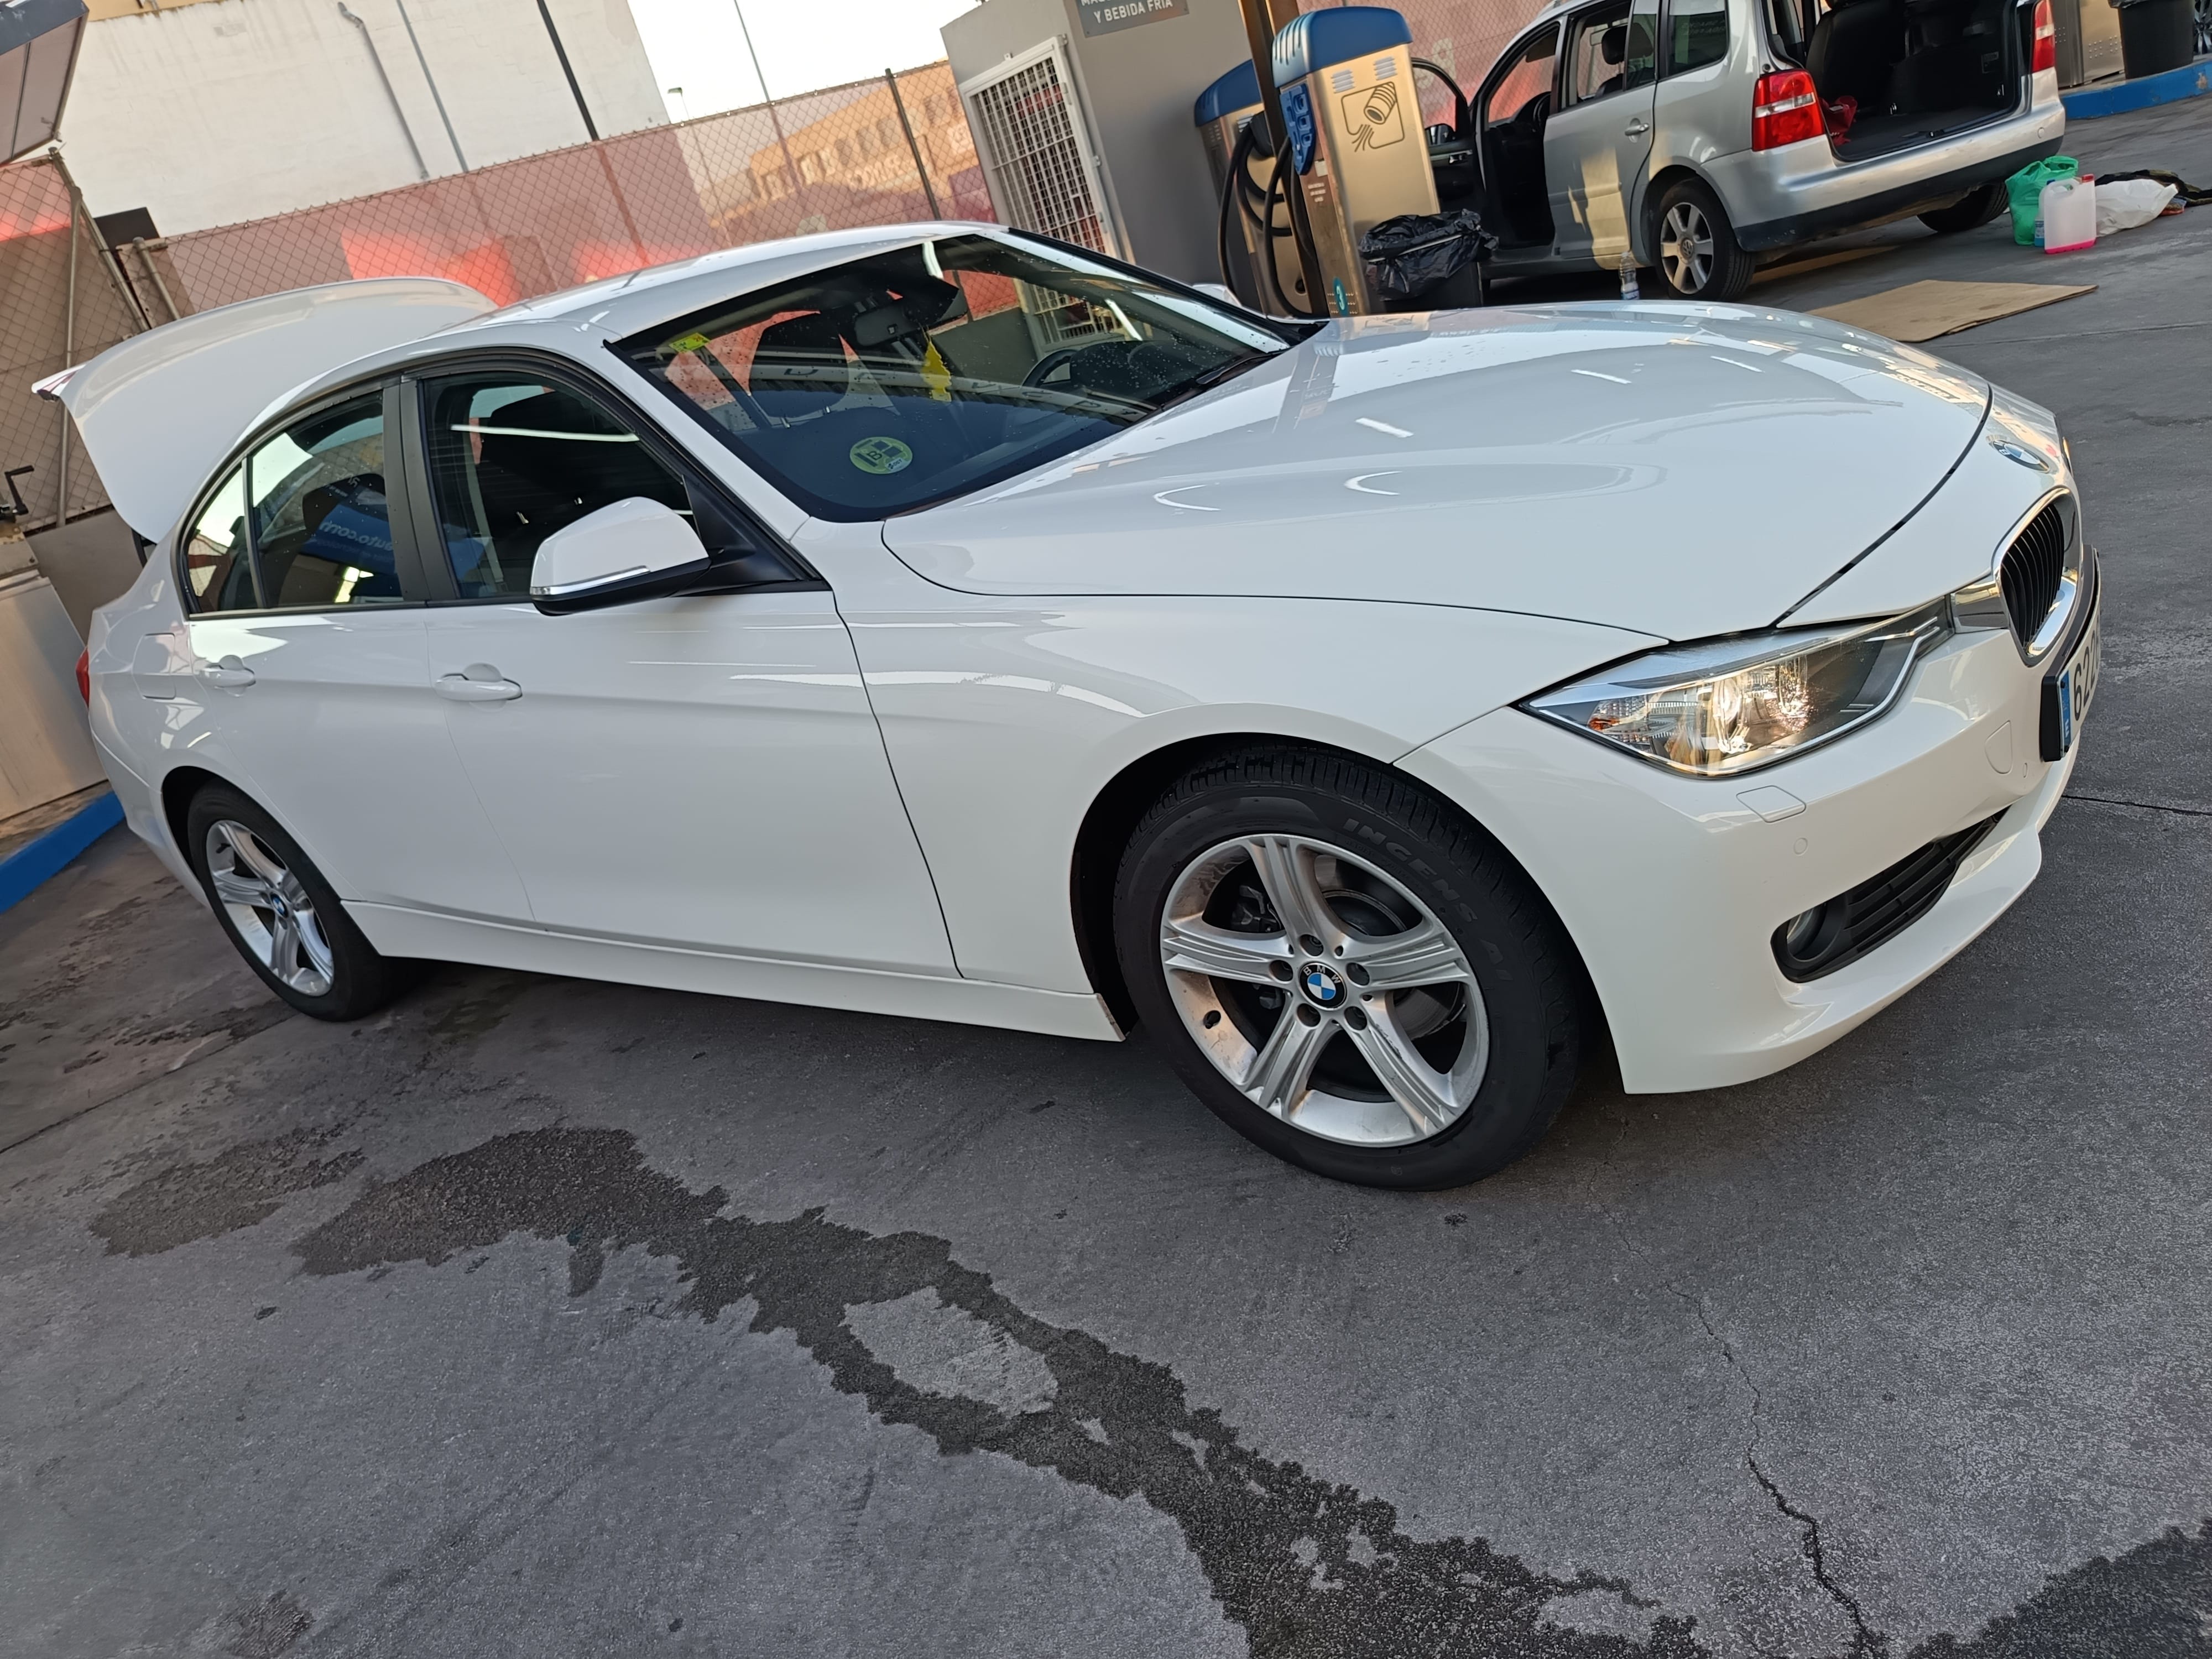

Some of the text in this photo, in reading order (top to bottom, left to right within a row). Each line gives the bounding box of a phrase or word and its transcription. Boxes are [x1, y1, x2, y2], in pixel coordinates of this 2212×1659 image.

[1093, 11, 1101, 23] Y
[1104, 2, 1146, 21] BEBIDA
[1336, 285, 1345, 310] 3
[1342, 818, 1478, 923] INGENS
[1303, 965, 1341, 984] BMW
